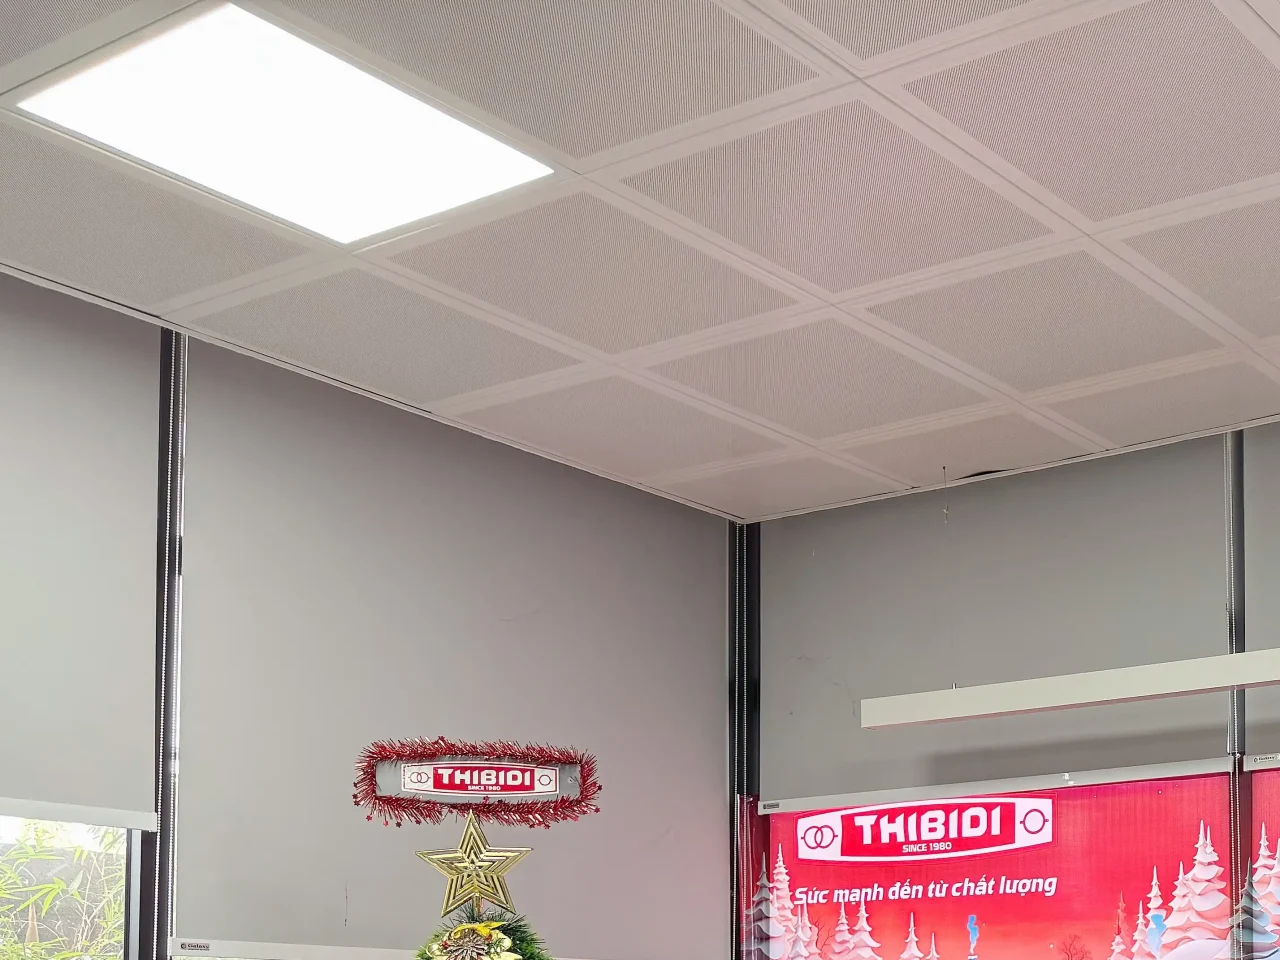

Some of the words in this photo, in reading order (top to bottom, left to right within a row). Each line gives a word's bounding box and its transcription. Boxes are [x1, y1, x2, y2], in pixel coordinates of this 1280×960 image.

[437, 768, 531, 786] THIBIDI
[854, 804, 1001, 845] THIBIDI
[902, 843, 928, 853] SINCE
[929, 841, 952, 851] 1980
[794, 884, 827, 905] Sức
[833, 882, 884, 904] mạnh
[888, 877, 924, 900] đến
[927, 878, 949, 898] từ
[951, 873, 995, 897] chất
[999, 875, 1057, 897] lượng
